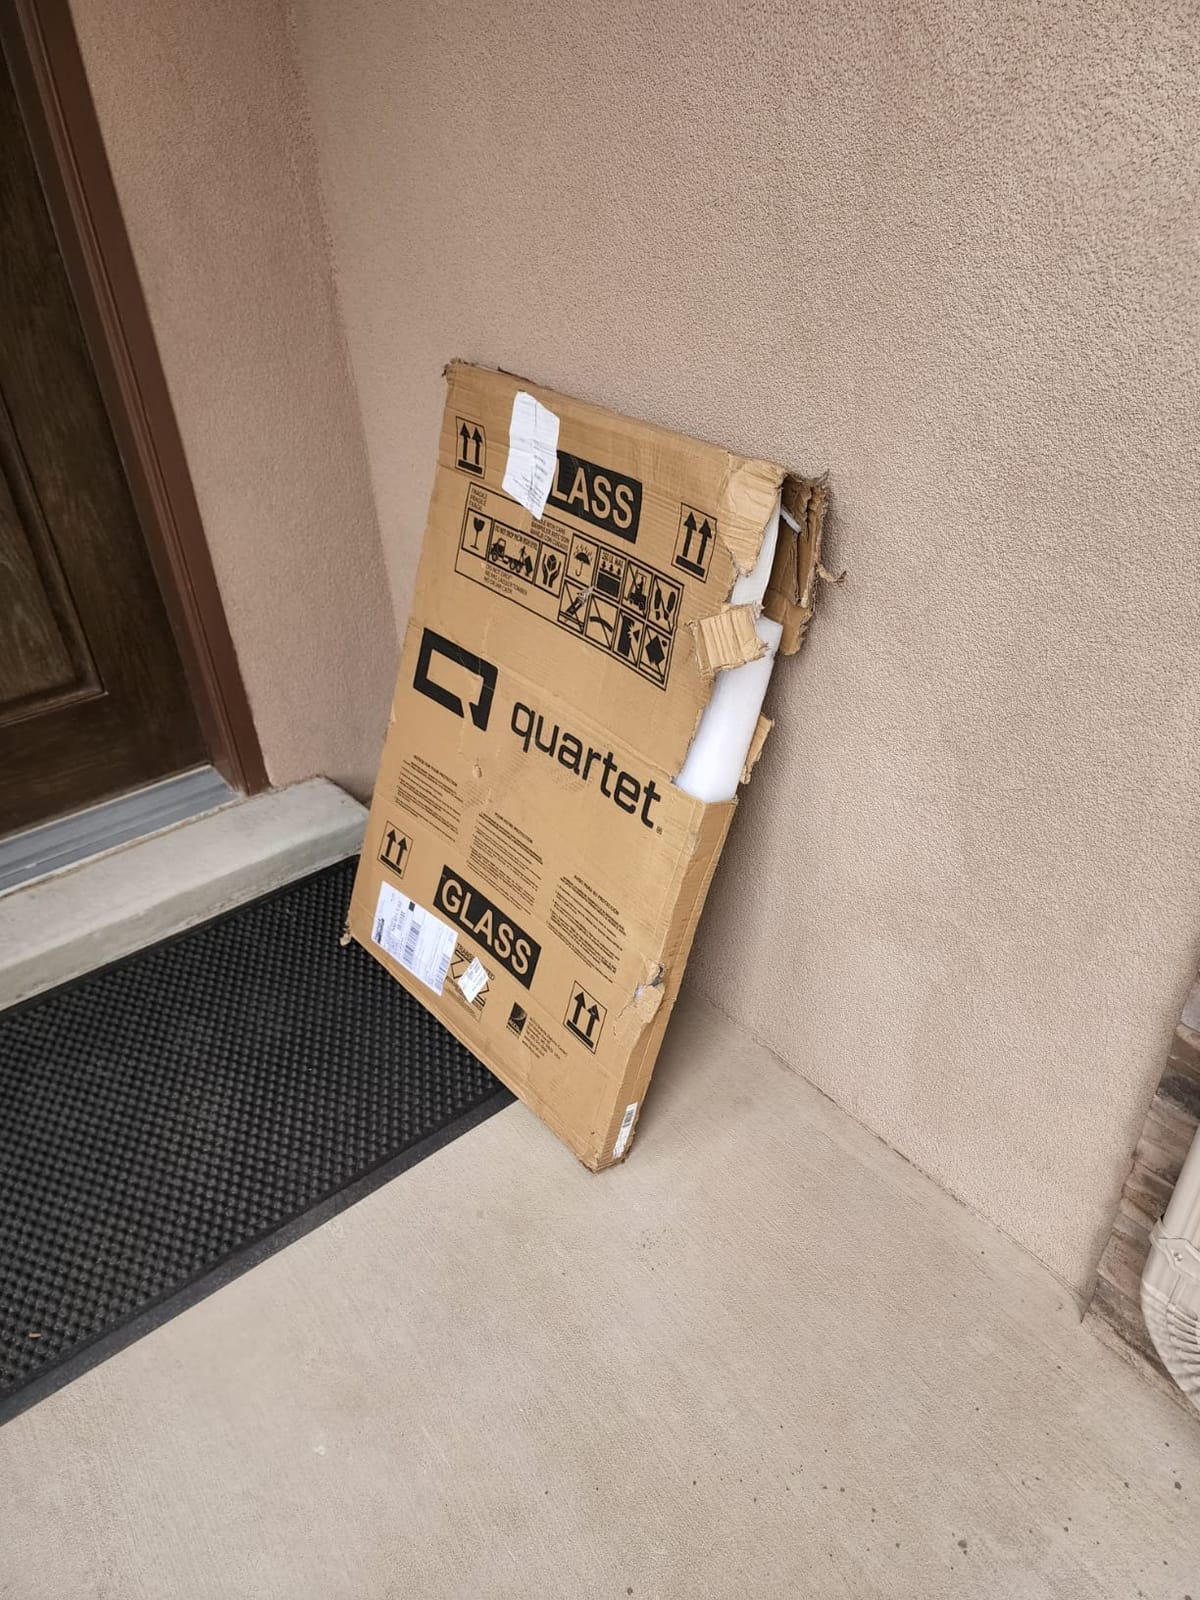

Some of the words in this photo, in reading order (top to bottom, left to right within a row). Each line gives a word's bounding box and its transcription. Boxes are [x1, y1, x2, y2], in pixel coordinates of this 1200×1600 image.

[551, 458, 635, 529] LASS
[511, 701, 661, 829] quartet
[441, 879, 532, 975] GLASS
